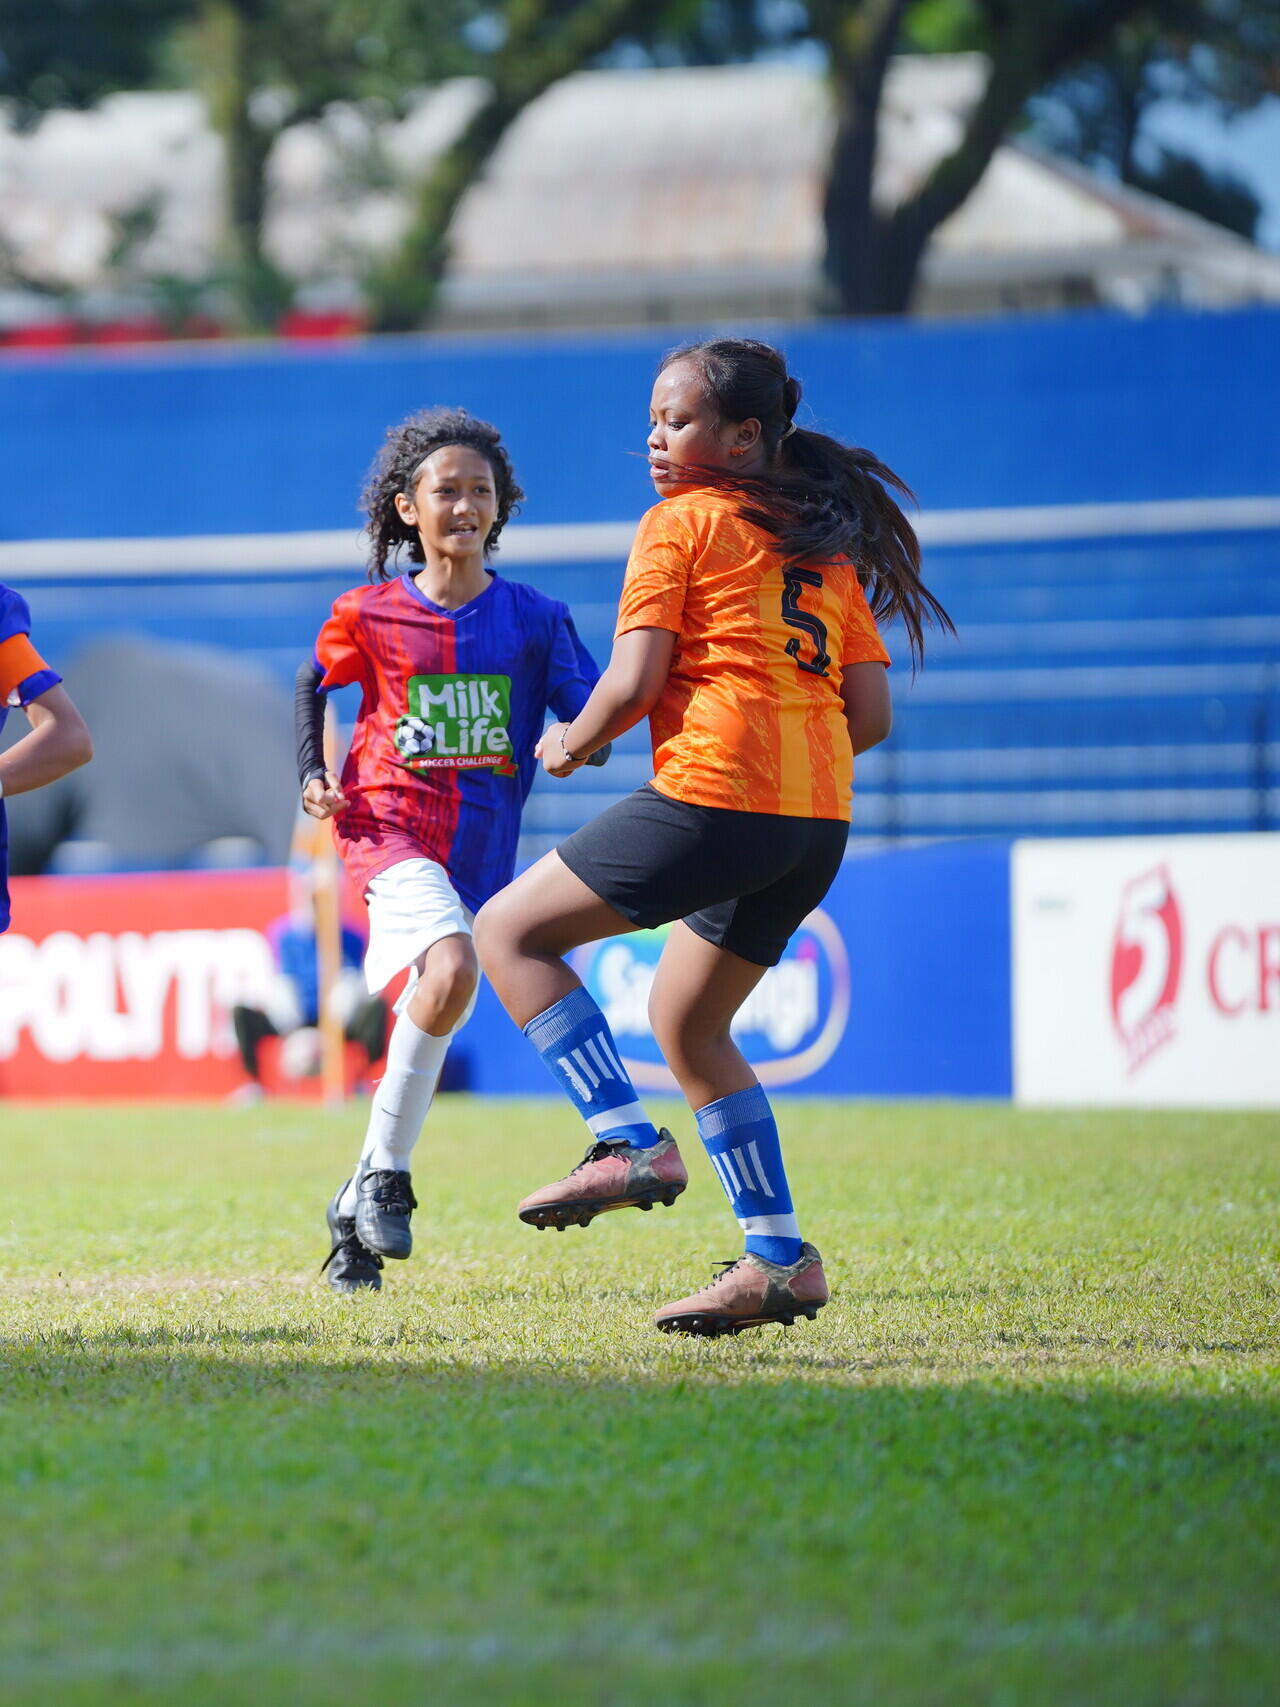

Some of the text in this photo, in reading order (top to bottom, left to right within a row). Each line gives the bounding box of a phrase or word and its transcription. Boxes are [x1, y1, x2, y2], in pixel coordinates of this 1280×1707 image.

[781, 566, 831, 678] 5
[418, 680, 503, 719] Milk
[435, 718, 510, 754] Life
[419, 755, 503, 768] SOCCER CHALLENGE
